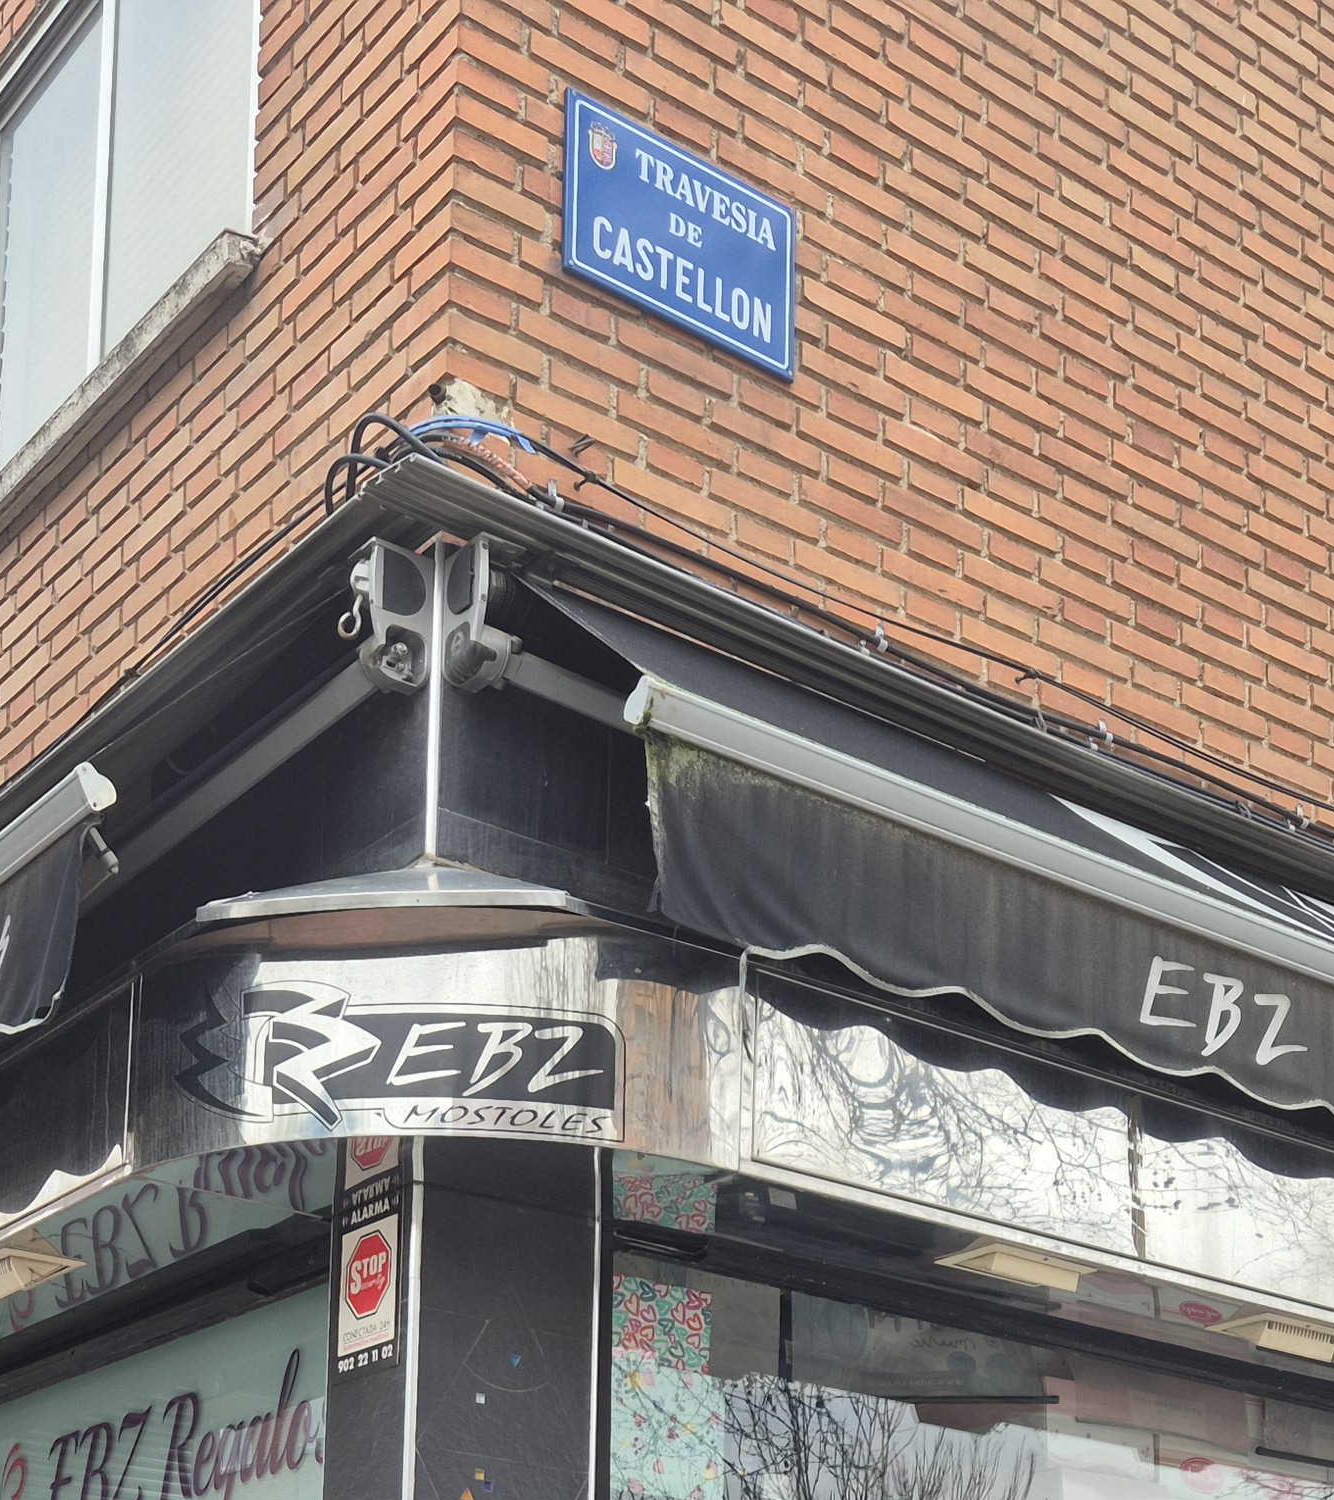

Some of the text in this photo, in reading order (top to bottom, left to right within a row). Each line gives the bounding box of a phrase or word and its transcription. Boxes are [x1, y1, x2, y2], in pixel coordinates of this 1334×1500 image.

[635, 148, 776, 251] TRAVESIA
[669, 212, 703, 248] DE
[593, 216, 772, 343] CASTELLON
[1139, 956, 1308, 1065] EBZ
[386, 1021, 604, 1097] EBZ
[403, 1104, 611, 1134] MOSTOLES
[350, 1197, 390, 1226] ALARMA
[350, 1252, 387, 1294] STOP
[342, 1323, 378, 1342] CONECTADA
[338, 1344, 393, 1374] 902 22 11 02
